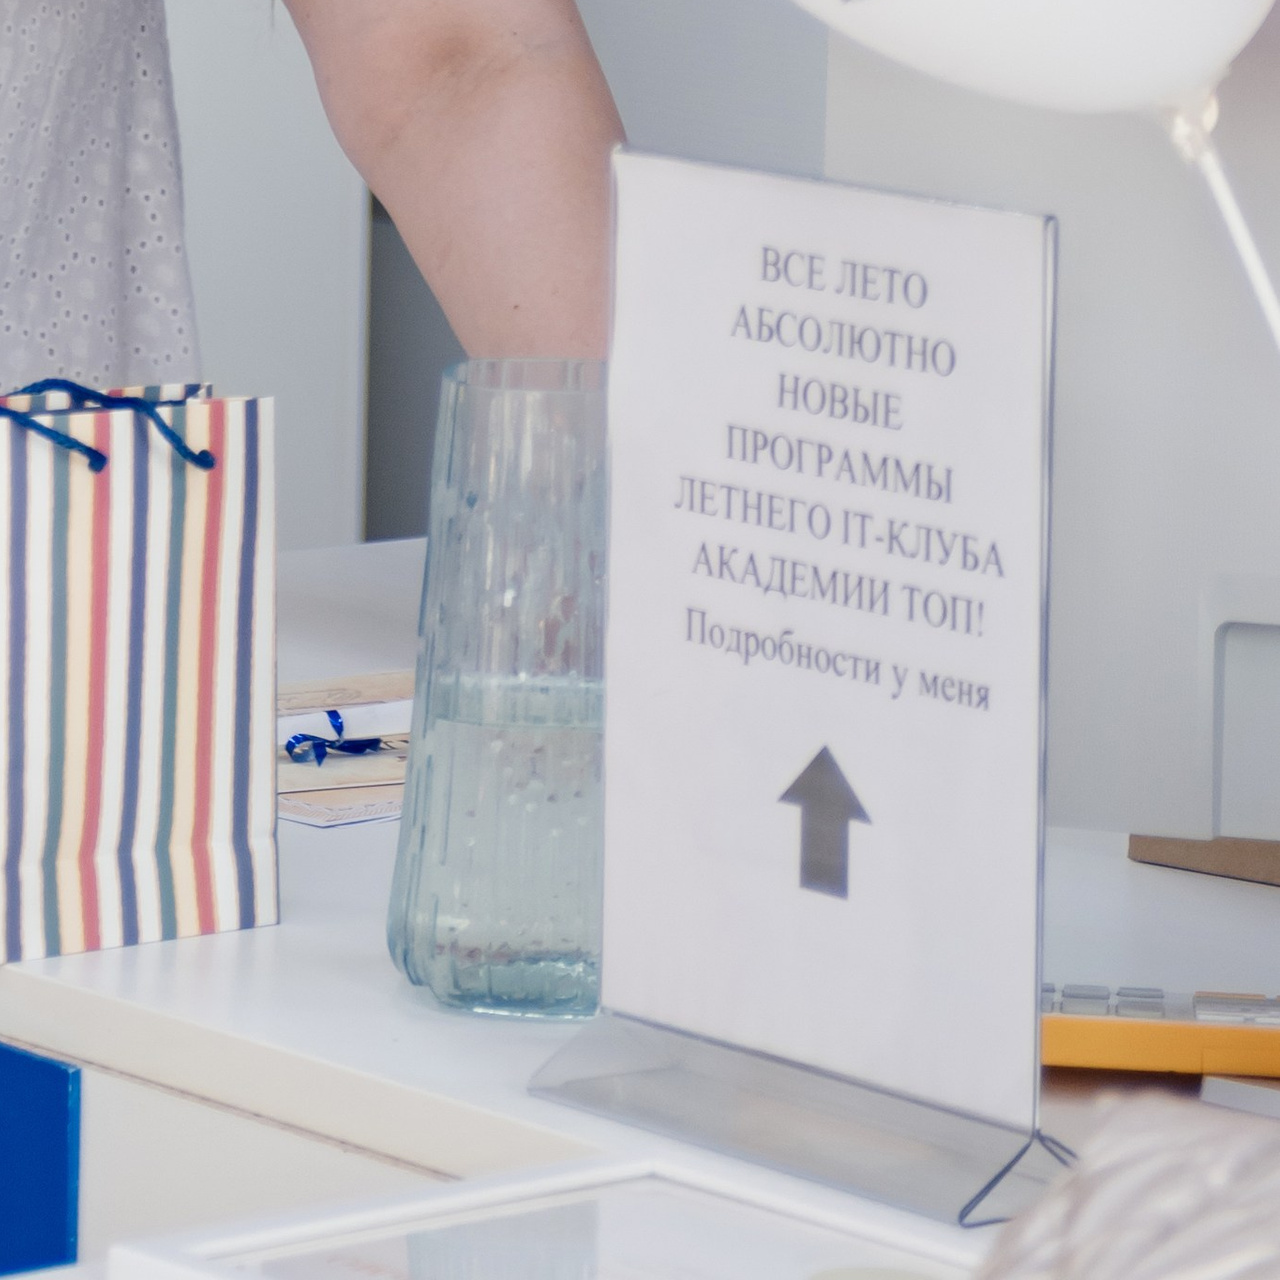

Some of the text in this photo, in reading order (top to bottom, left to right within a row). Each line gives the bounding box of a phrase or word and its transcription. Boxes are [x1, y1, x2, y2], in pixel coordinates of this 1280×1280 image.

[761, 245, 929, 309] ВСЕ ЛЕТО
[730, 304, 957, 378] АБСОЛЮТНО
[777, 372, 903, 431] НОВЫЕ
[725, 424, 954, 505] ПРОГРАММЫ
[674, 475, 832, 541] ЛЕТНЕГО
[692, 541, 985, 638] АКАДЕМИИ ТОП!
[686, 607, 991, 711] Подробности у меня
